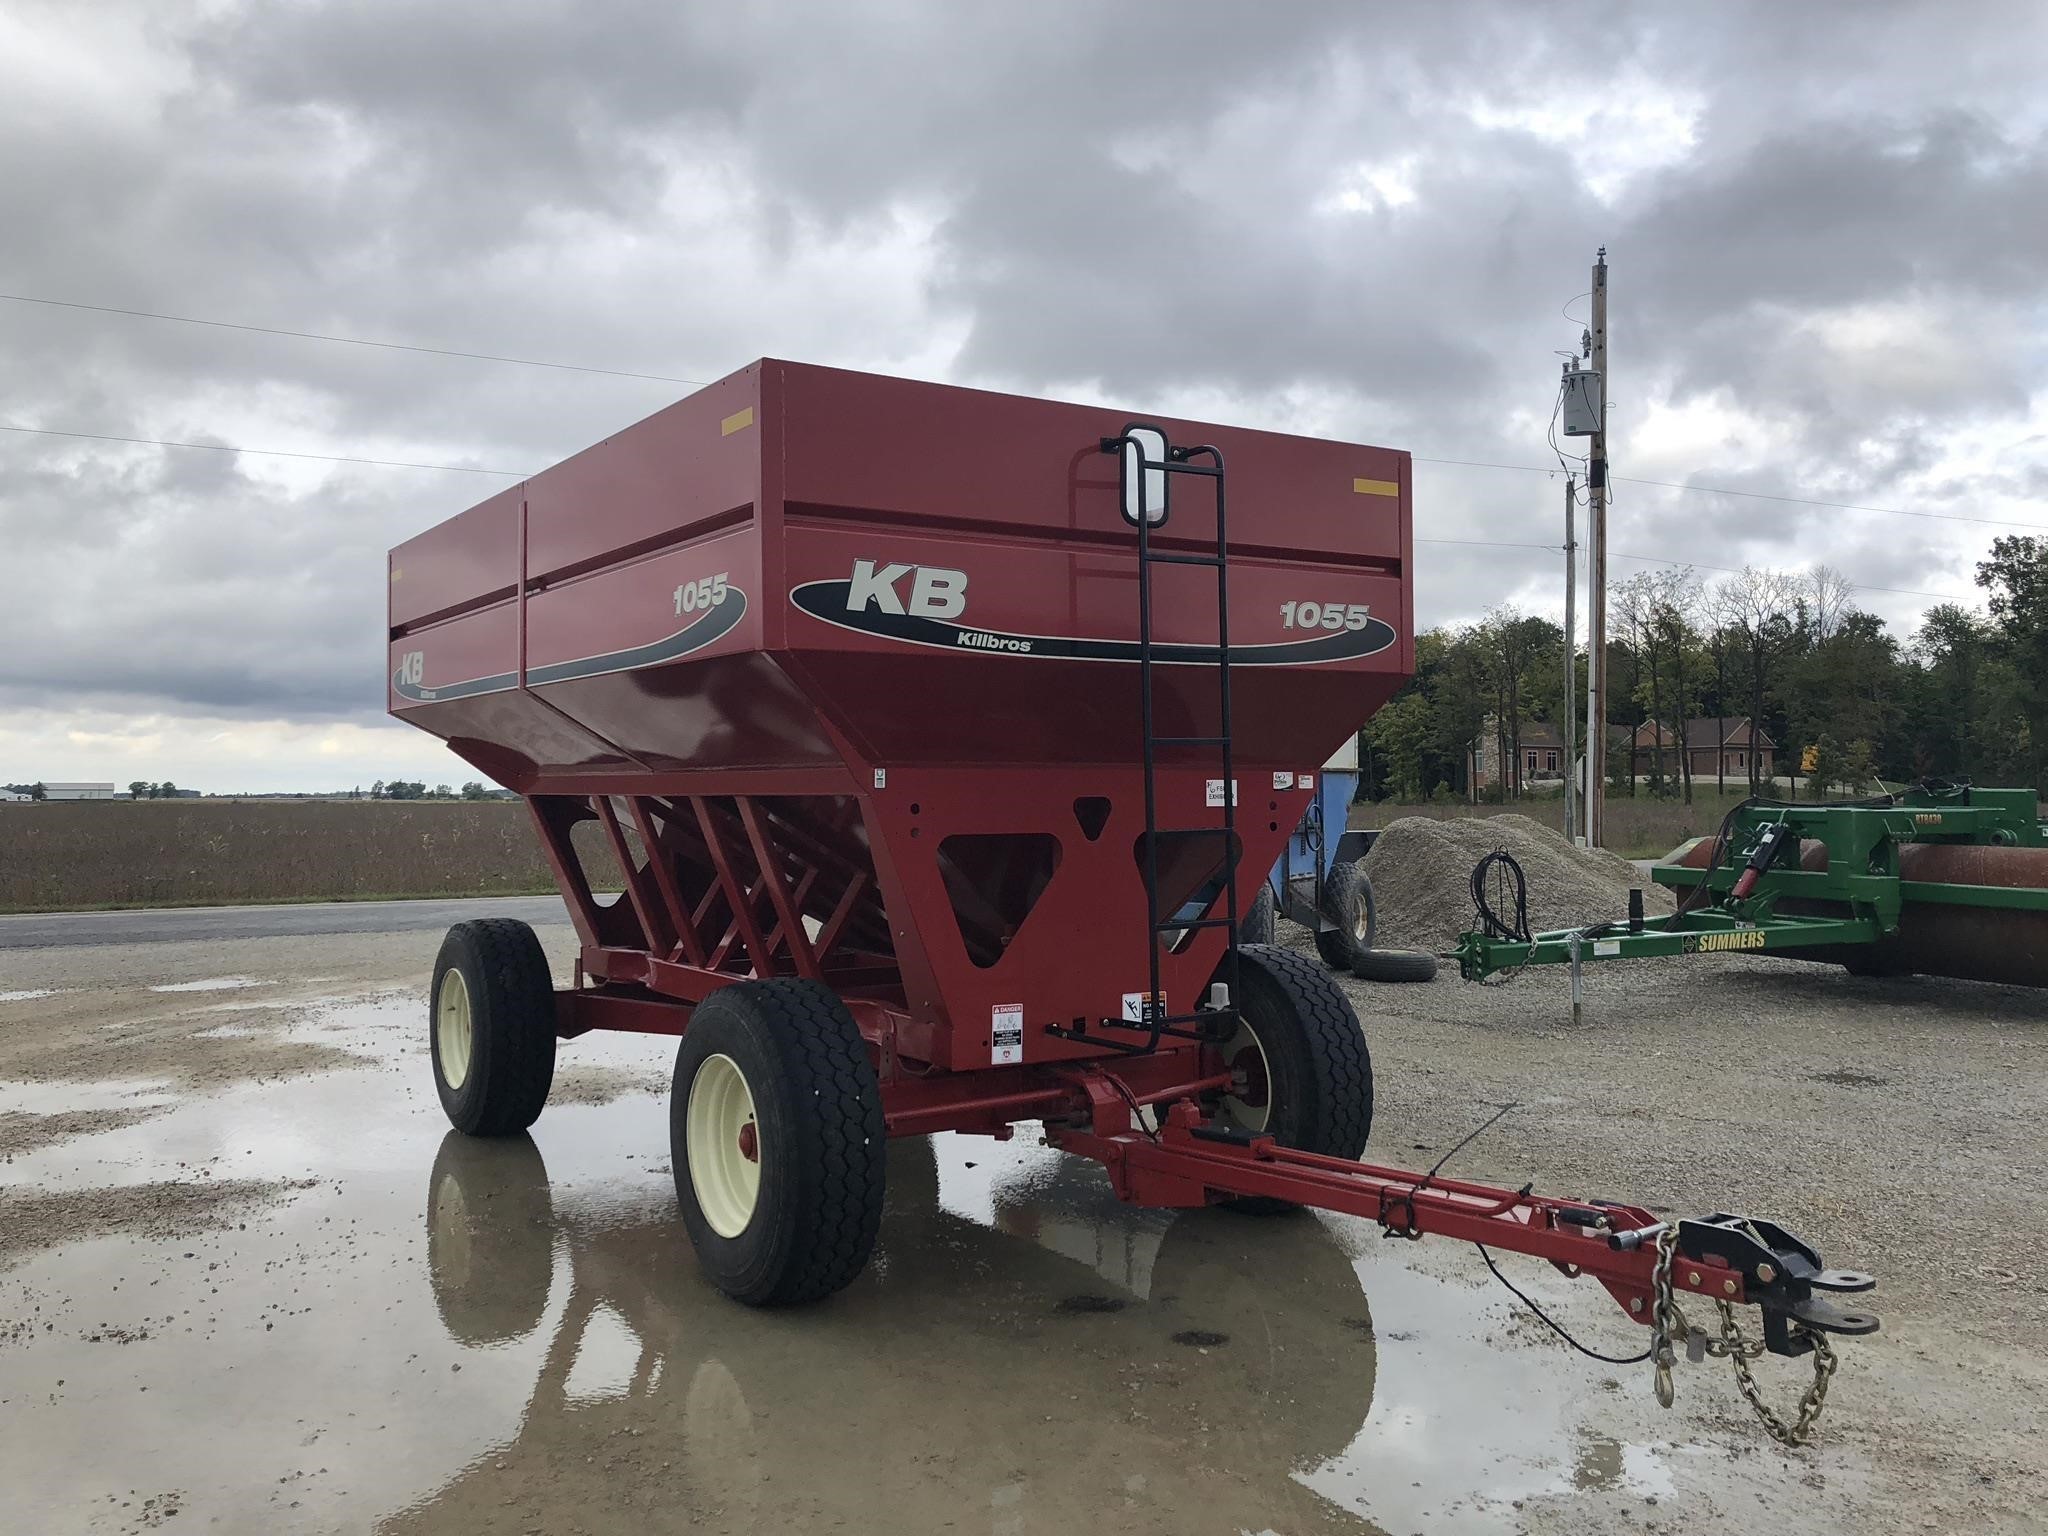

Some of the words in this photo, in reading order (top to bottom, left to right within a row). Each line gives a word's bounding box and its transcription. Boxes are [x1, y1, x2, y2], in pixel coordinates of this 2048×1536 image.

[673, 571, 729, 617] 1055
[846, 558, 968, 619] KB
[1280, 601, 1370, 631] 1055
[957, 631, 1032, 653] Killbros
[401, 651, 424, 686] KB
[1699, 930, 1765, 952] SUMMERS
